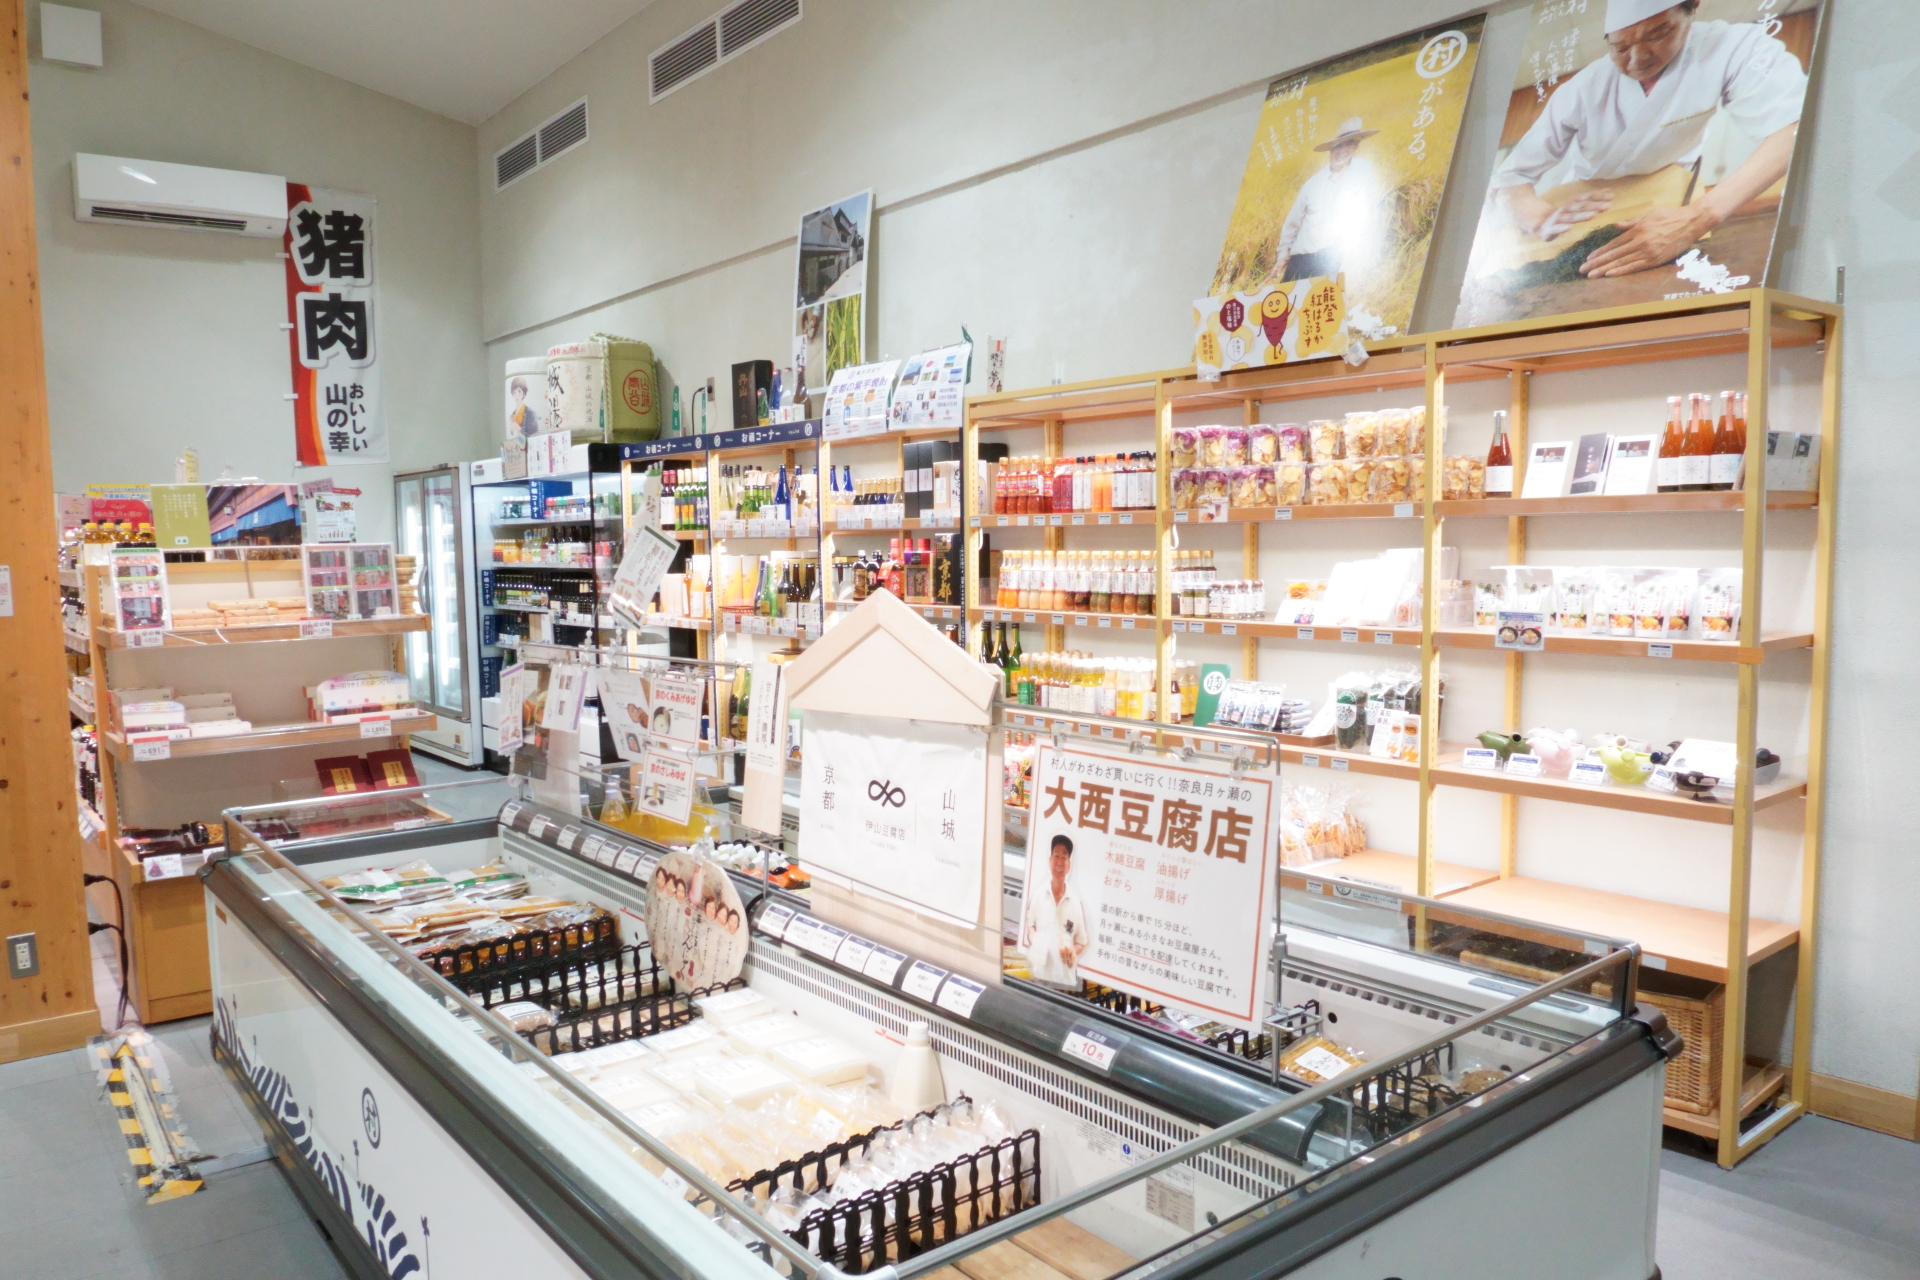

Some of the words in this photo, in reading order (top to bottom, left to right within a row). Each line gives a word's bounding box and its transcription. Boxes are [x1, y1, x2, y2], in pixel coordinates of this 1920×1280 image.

[295, 209, 368, 361] 猪肉
[1311, 293, 1323, 345] 紅はるか
[1323, 286, 1338, 323] 能登
[1303, 308, 1312, 348] ちっぷす
[585, 366, 593, 381] 京都
[325, 383, 350, 453] 山の幸
[349, 382, 368, 452] おいしい
[742, 428, 781, 443] お酒コーナー
[645, 442, 677, 454] お酒コーナー
[531, 481, 539, 518] お酒コーナー
[655, 690, 697, 706] 京のくみあげゆば
[650, 763, 686, 781] 京のさしみゆば
[821, 765, 836, 811] 京都
[865, 819, 906, 842] 伊山豆腐店
[941, 789, 956, 842] 山城
[1043, 776, 1254, 864] 大西豆腐店
[1105, 850, 1146, 871] 木綿豆腐
[1156, 861, 1191, 881] 油揚げ
[1103, 874, 1132, 892] おから
[1153, 886, 1188, 906] 厚揚げ
[1096, 948, 1237, 999] 手作りの昔ながらの美味しい豆腐です。
[1086, 1030, 1107, 1044] 保冷剤
[362, 1093, 380, 1146] 村
